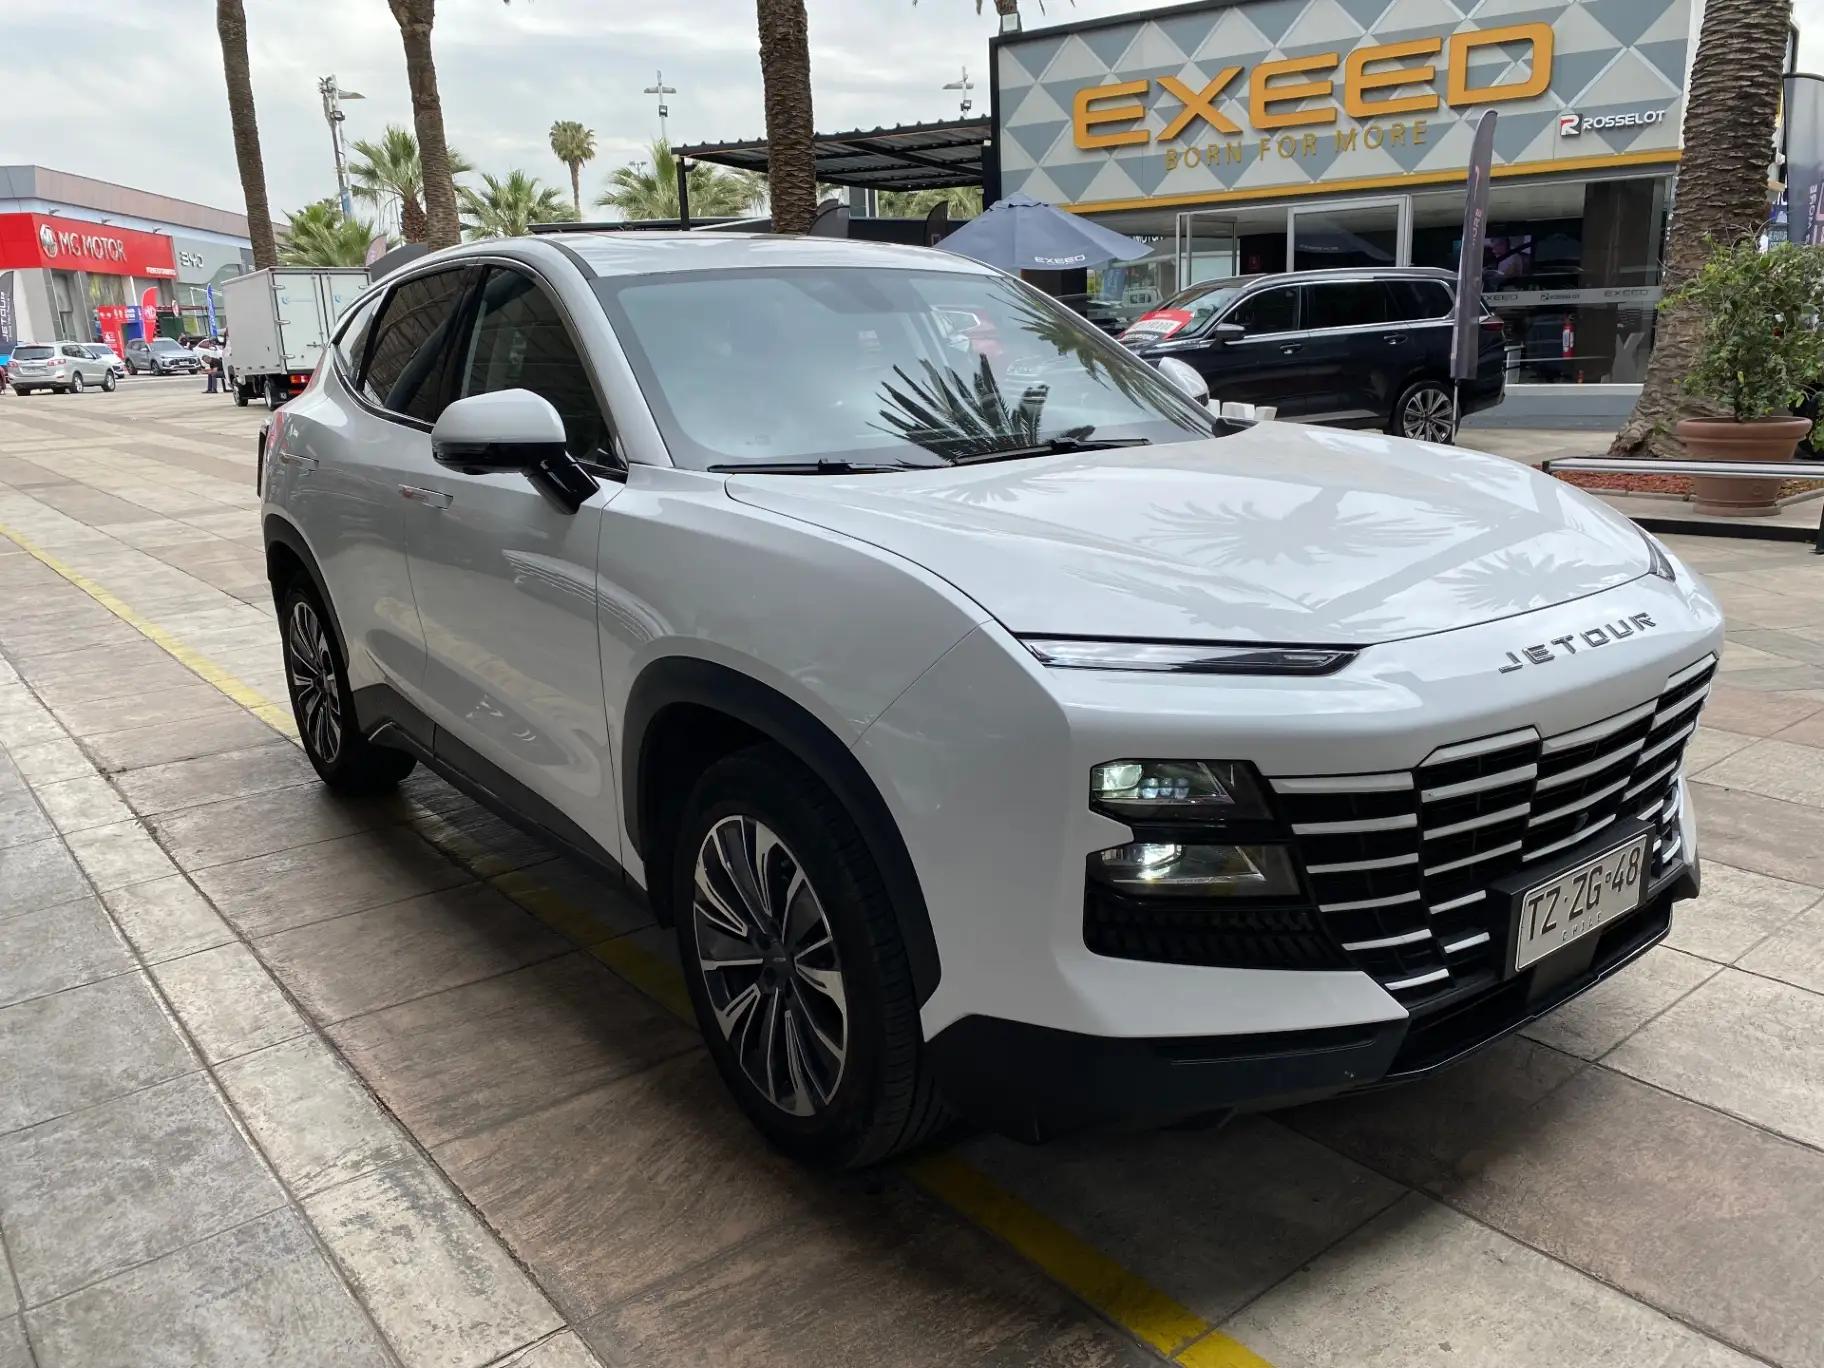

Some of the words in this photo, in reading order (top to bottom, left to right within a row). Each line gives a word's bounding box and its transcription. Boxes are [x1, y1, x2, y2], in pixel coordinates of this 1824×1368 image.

[1073, 22, 1555, 151] EXEED
[1583, 110, 1665, 129] ROSSELOT
[1166, 141, 1242, 171] BORN
[1259, 133, 1317, 161] FOR
[1336, 120, 1427, 153] MORE
[58, 231, 81, 256] MG
[82, 235, 127, 262] MOTOR
[180, 251, 205, 268] BYD
[1034, 254, 1086, 265] EXEED
[1604, 289, 1649, 297] EXEED
[1498, 612, 1656, 674] JETOUR
